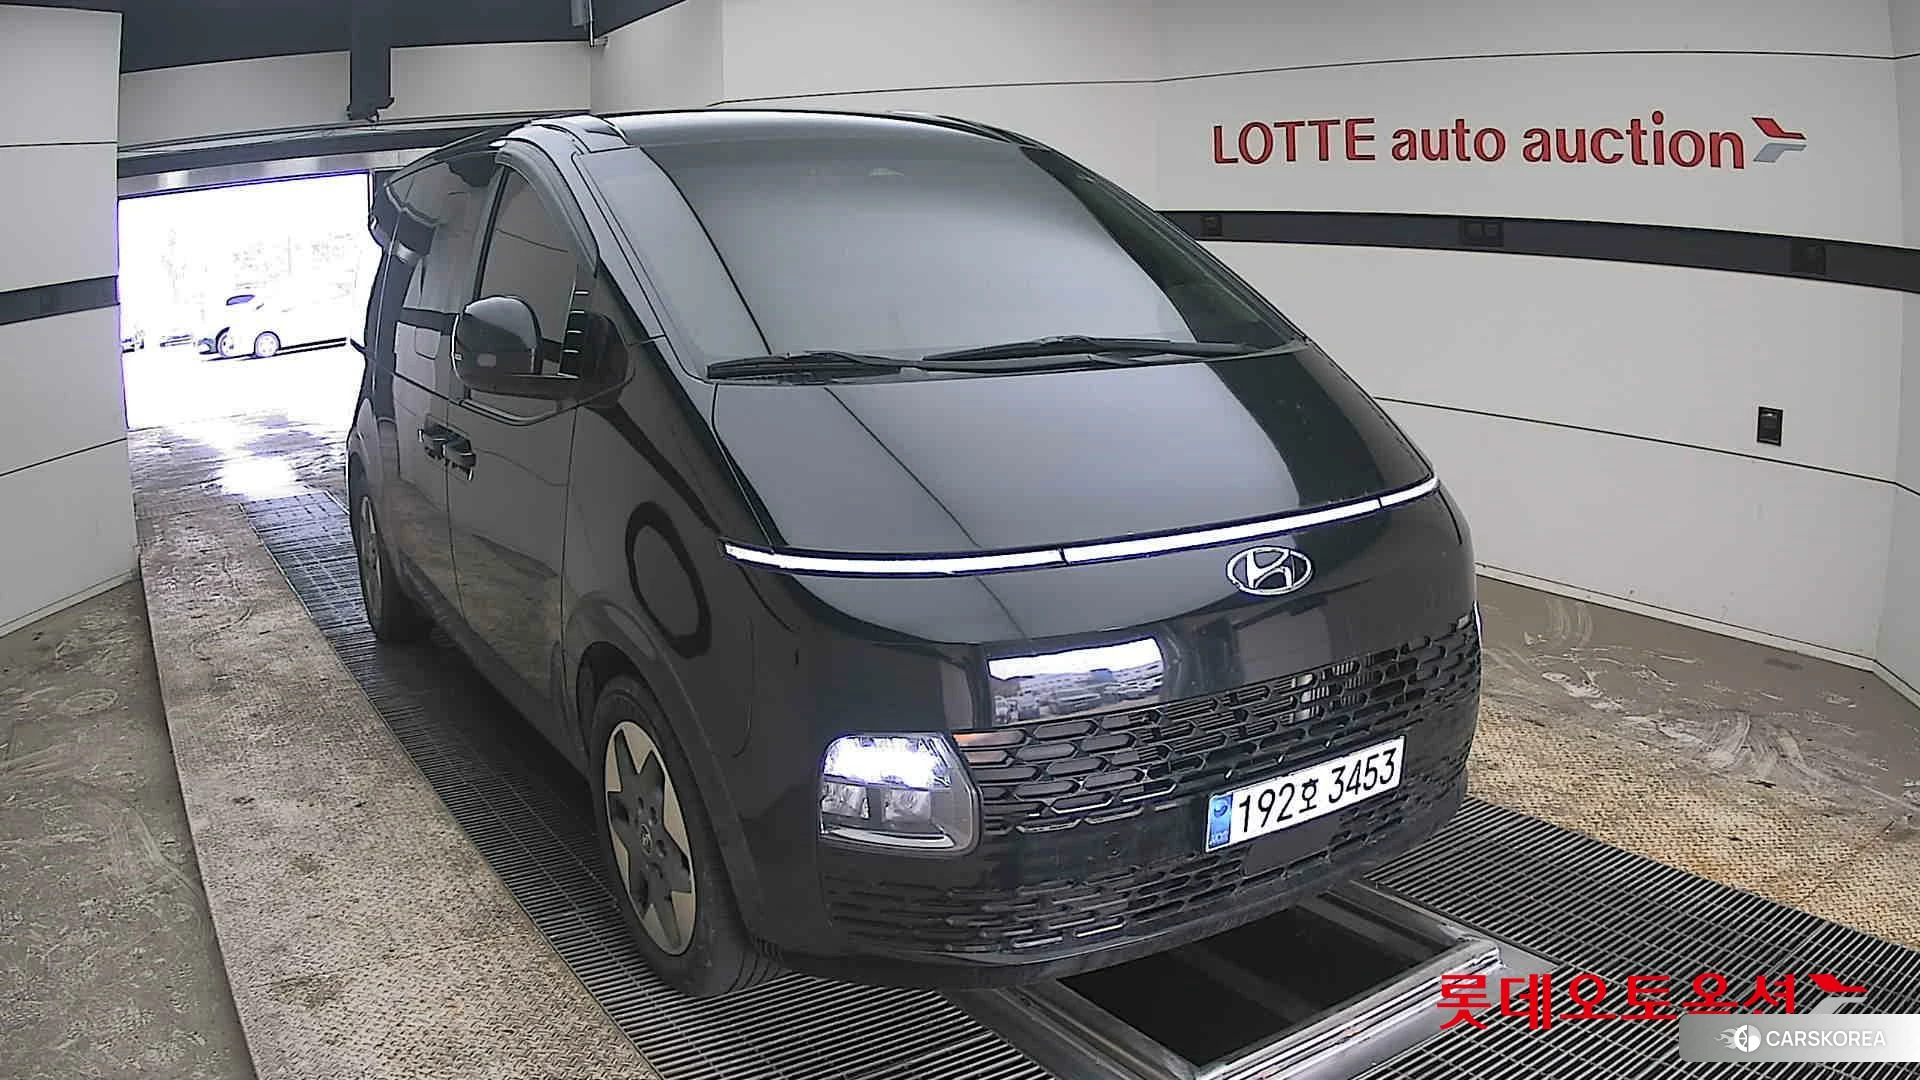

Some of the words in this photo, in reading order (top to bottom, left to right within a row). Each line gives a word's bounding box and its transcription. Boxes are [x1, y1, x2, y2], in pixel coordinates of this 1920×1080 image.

[1213, 118, 1376, 165] LOTTE
[1391, 118, 1507, 163] auto
[1522, 110, 1746, 170] auction
[1239, 778, 1320, 833] 192호
[1329, 747, 1397, 804] 3453
